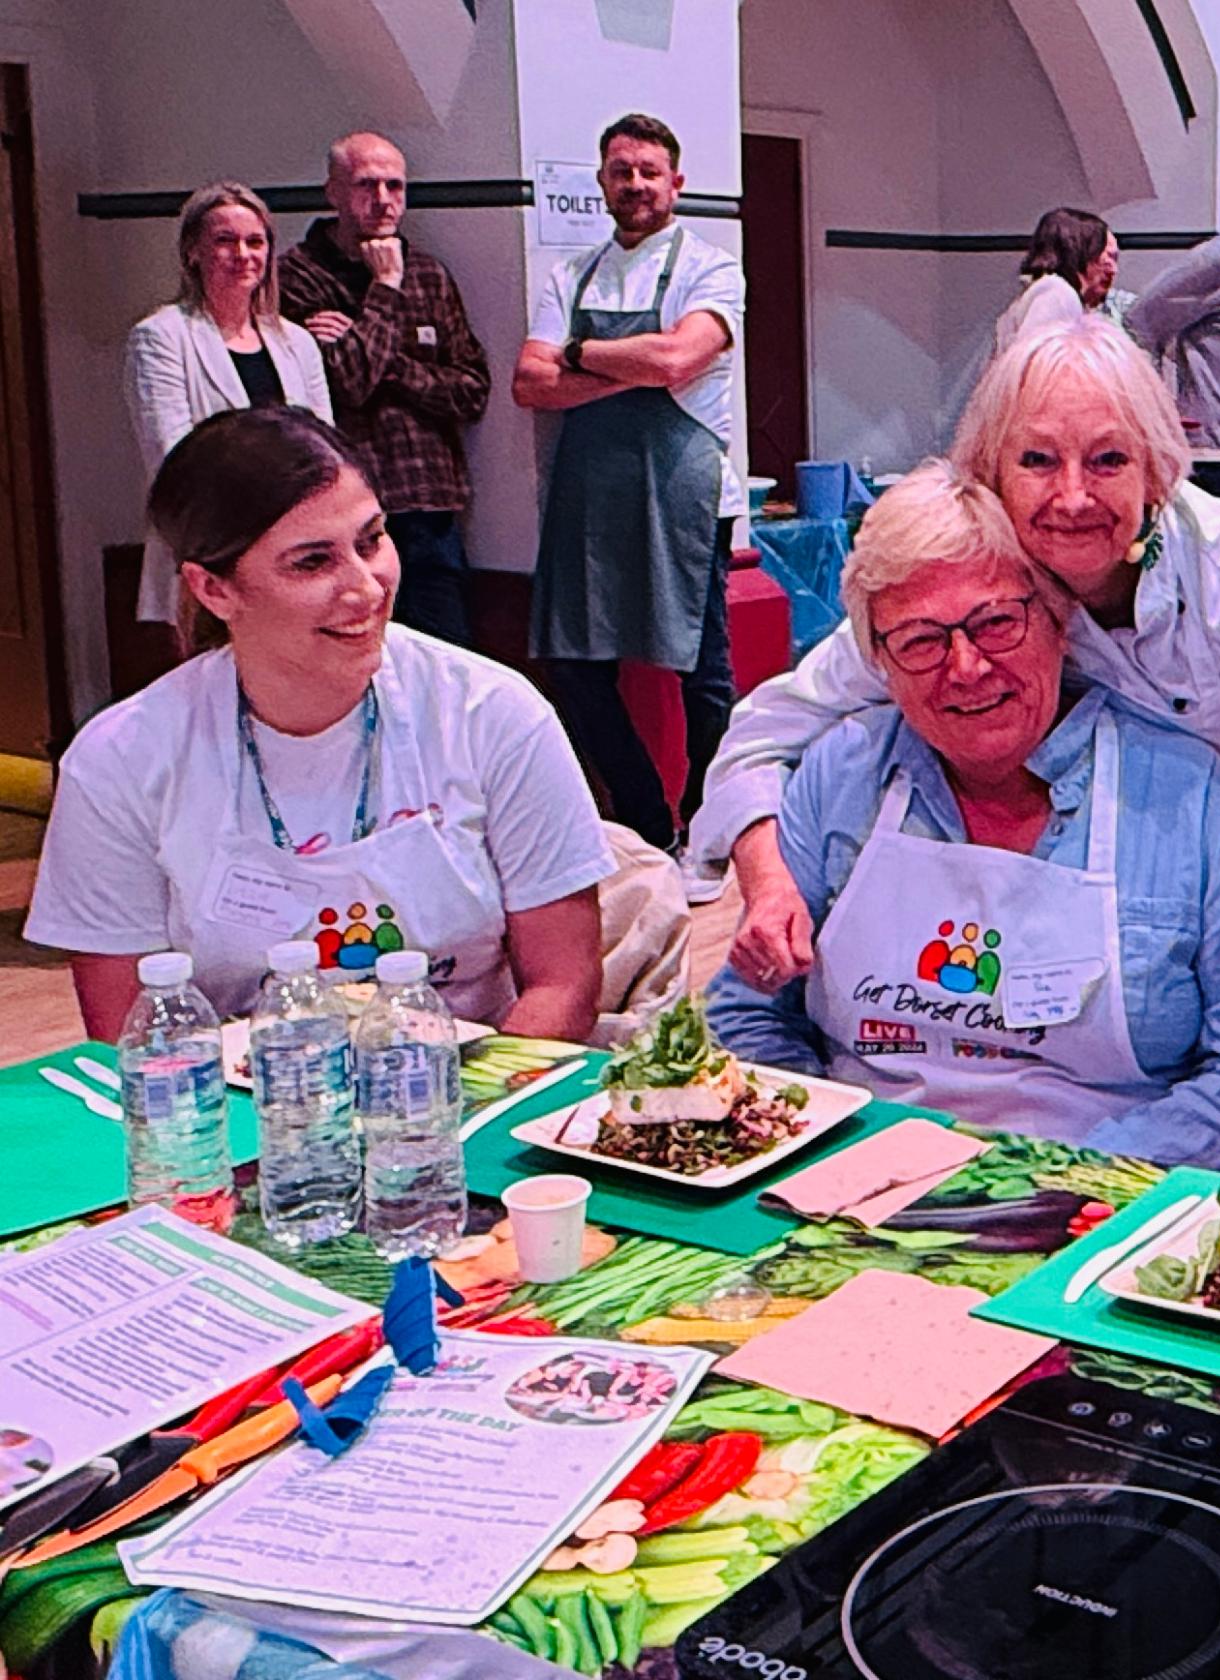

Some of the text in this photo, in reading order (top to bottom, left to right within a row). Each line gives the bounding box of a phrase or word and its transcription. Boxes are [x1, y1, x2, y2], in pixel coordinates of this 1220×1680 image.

[546, 195, 605, 215] TOILET
[853, 975, 893, 1004] Get
[894, 983, 968, 1021] Dorset
[863, 1023, 912, 1040] LIVE
[437, 1407, 482, 1424] THE
[477, 1415, 524, 1432] DAY
[1033, 1584, 1118, 1618] INDUCTION
